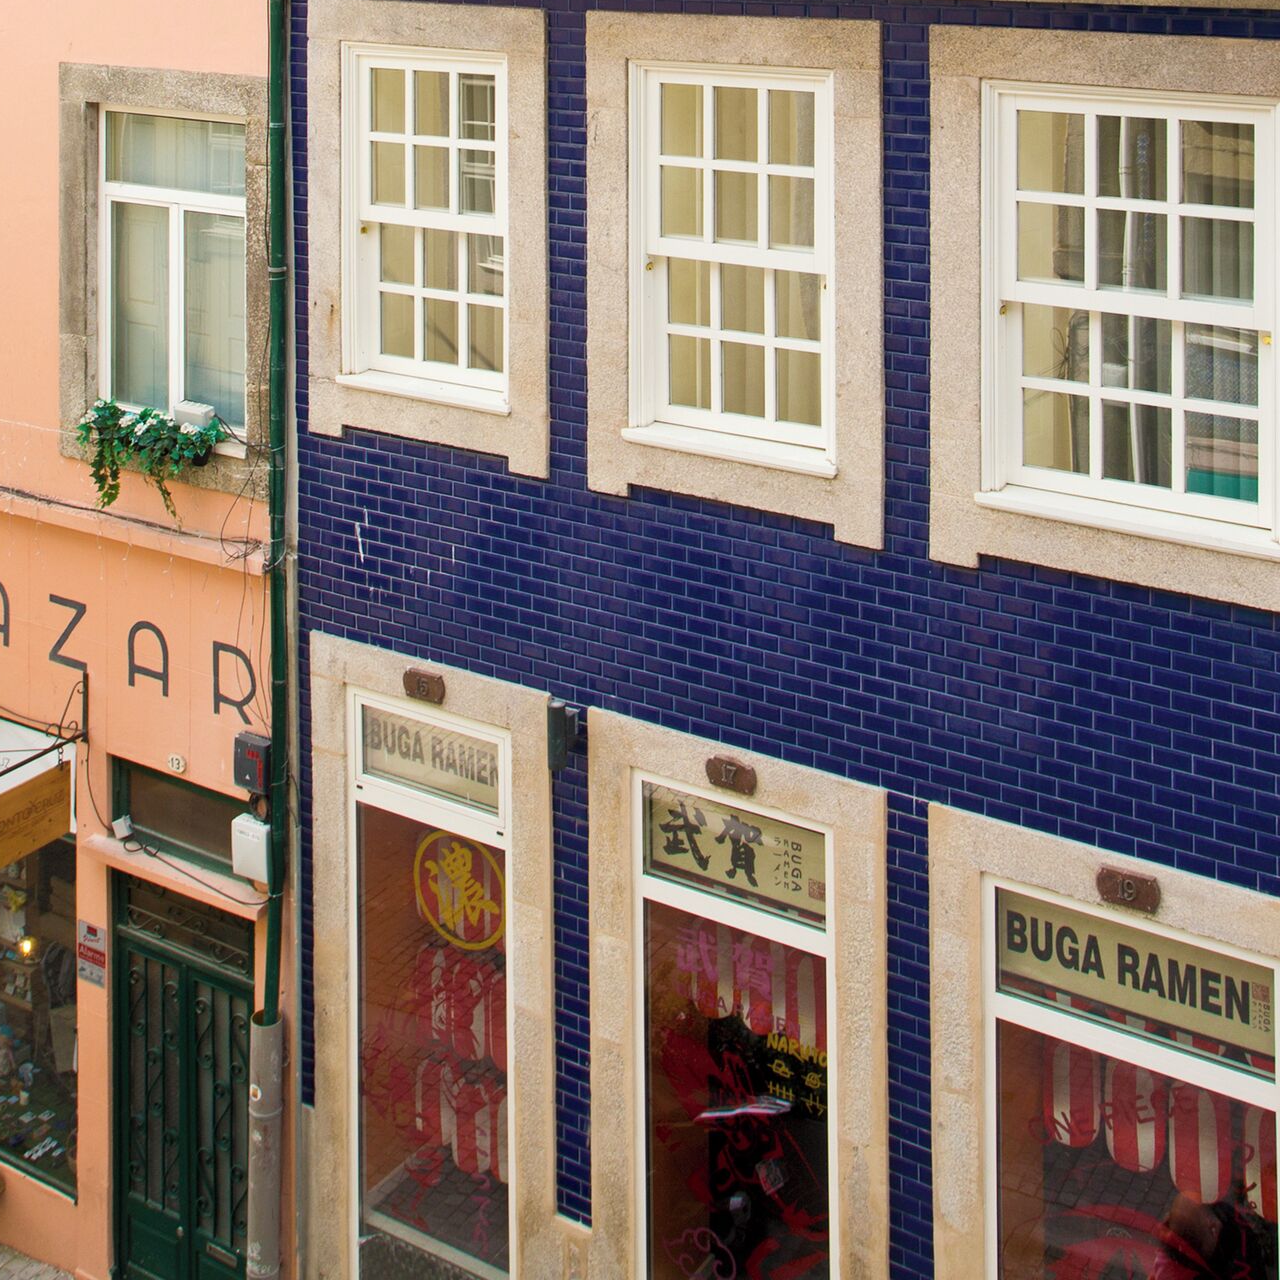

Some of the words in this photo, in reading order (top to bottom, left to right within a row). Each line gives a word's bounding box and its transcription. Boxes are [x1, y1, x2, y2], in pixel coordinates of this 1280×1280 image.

[170, 757, 181, 770] 13
[370, 718, 425, 765] BUGA
[431, 735, 499, 788] RAMEN
[721, 764, 737, 784] 17
[658, 799, 765, 887] 武賀
[772, 836, 782, 886] ラーメン
[791, 841, 803, 891] BUGA
[1118, 878, 1137, 902] 19
[1006, 909, 1106, 980] BUGA
[1117, 943, 1250, 1025] RAMEN
[767, 1031, 828, 1068] NARUTO
